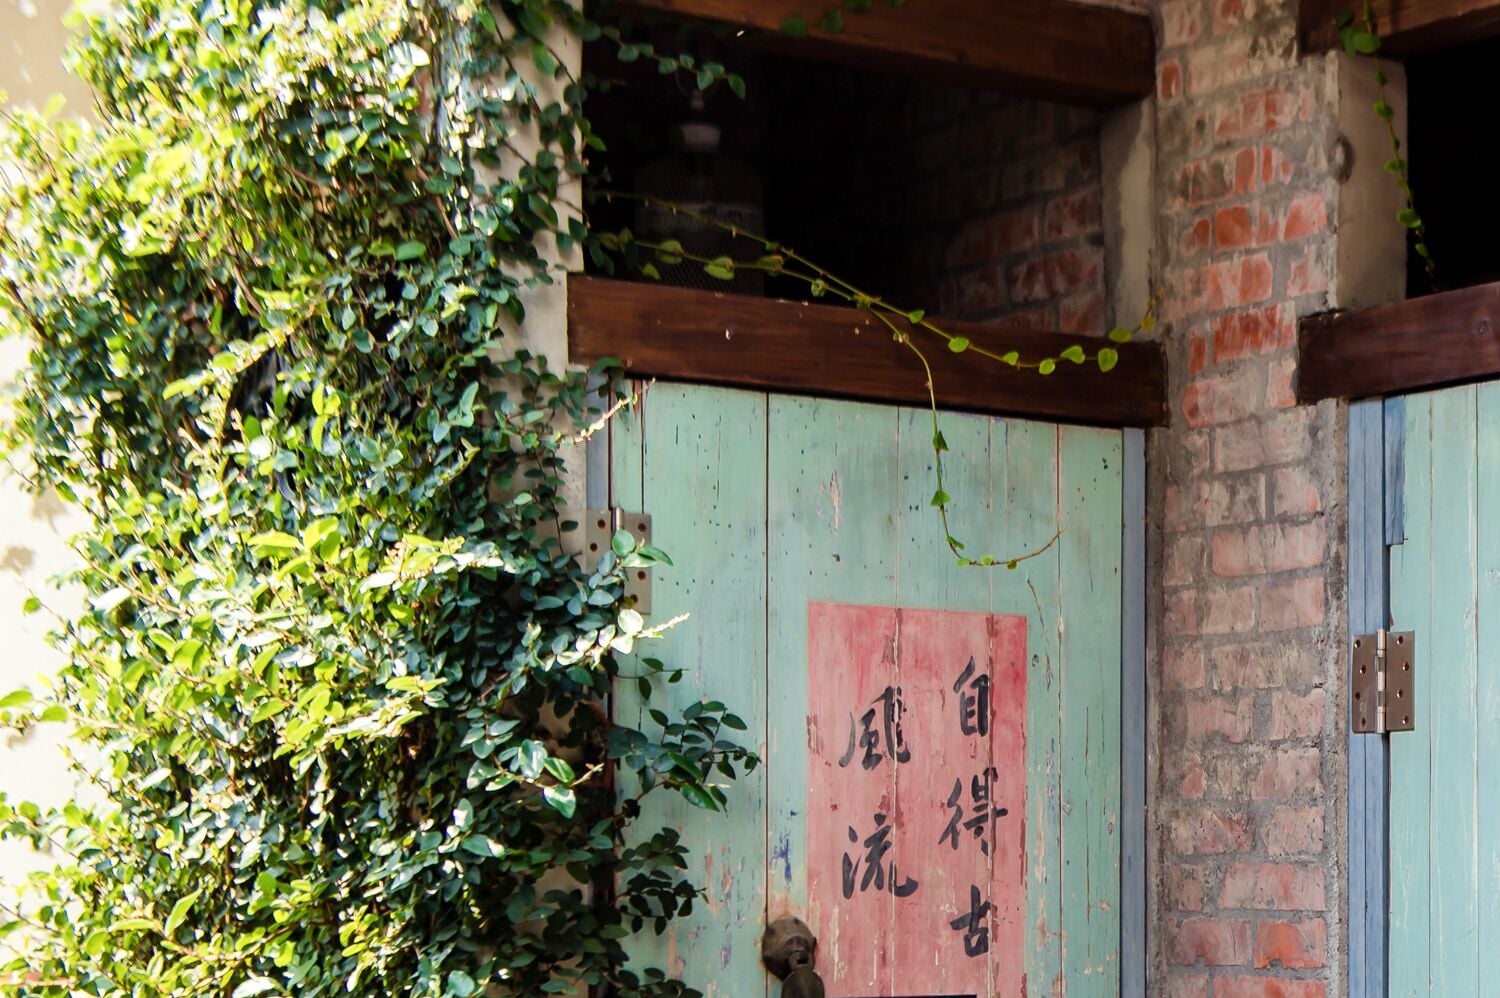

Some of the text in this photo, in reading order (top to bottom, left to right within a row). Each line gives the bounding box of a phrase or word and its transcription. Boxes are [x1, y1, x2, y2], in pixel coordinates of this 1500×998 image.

[838, 686, 918, 899] 風流
[938, 656, 1008, 958] 自得古
